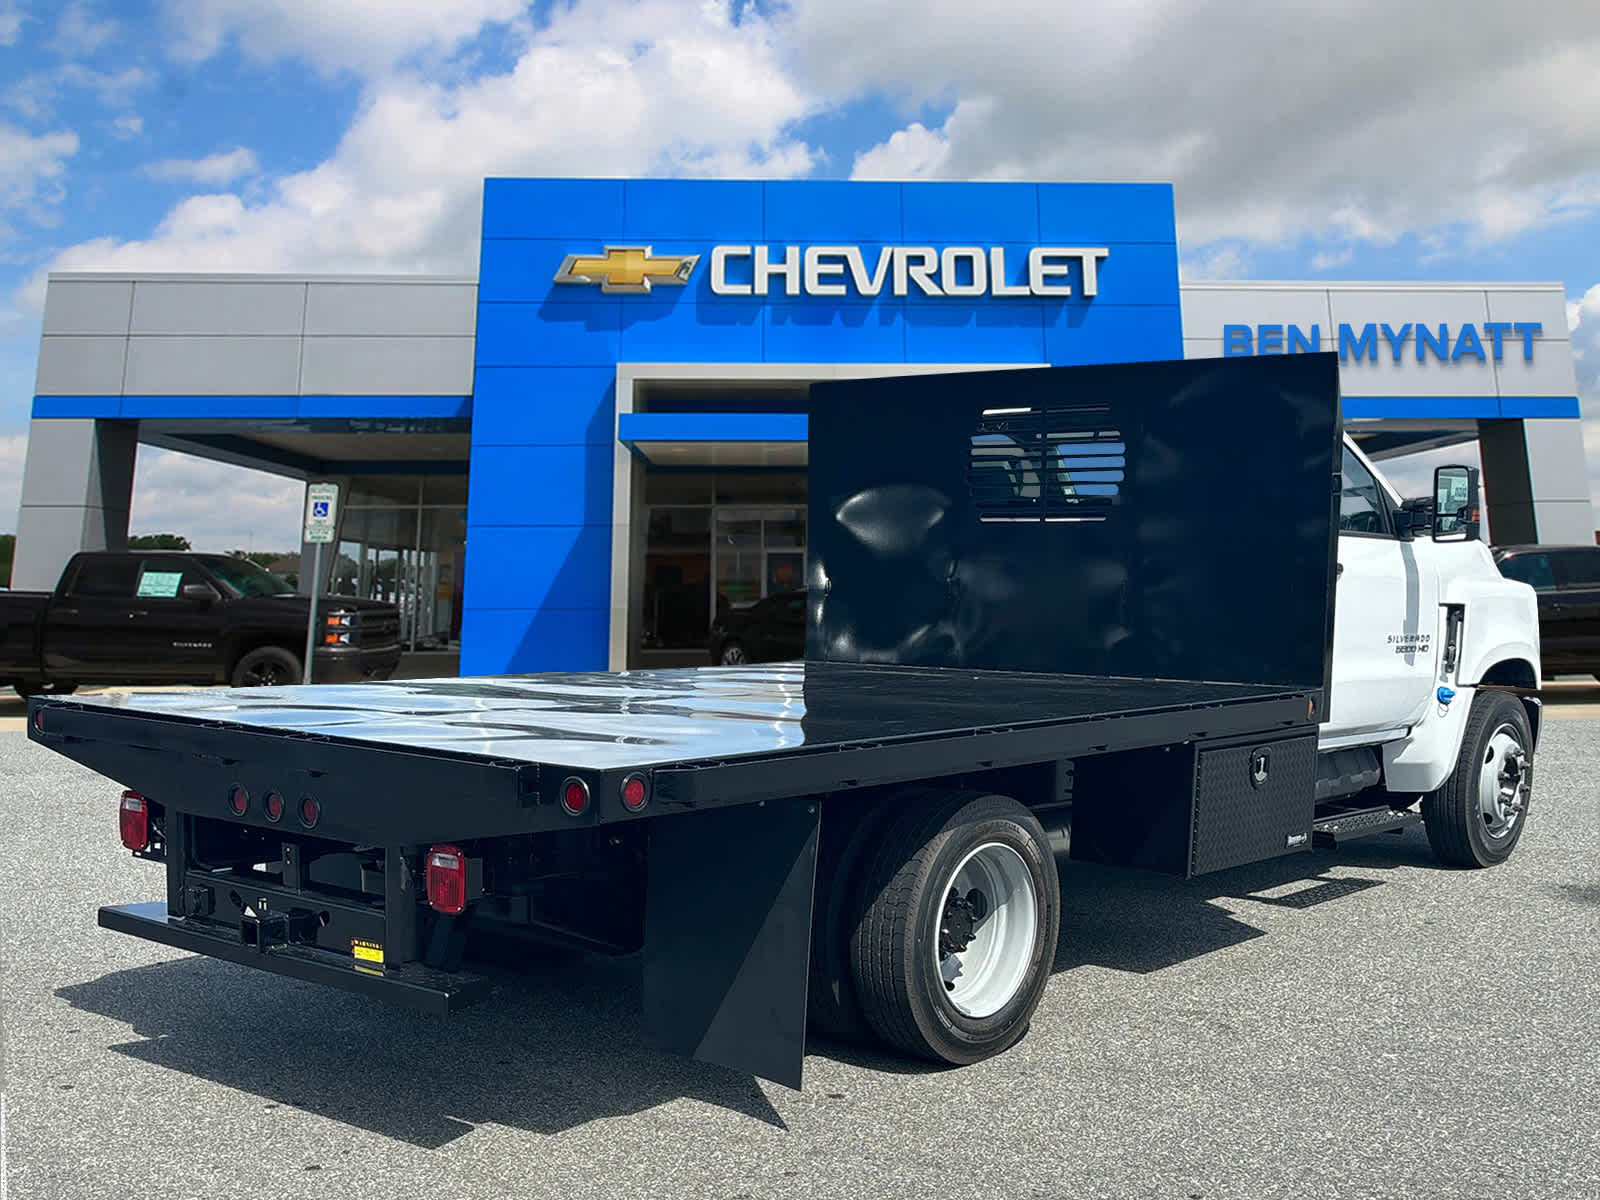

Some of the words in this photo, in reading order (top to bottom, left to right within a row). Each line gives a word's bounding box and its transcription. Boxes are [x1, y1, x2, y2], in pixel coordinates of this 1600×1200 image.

[711, 245, 1109, 296] CHEVROLET
[1223, 324, 1320, 358] BEN
[1338, 322, 1542, 362] MYNATT
[1387, 634, 1430, 644] SILVERADO
